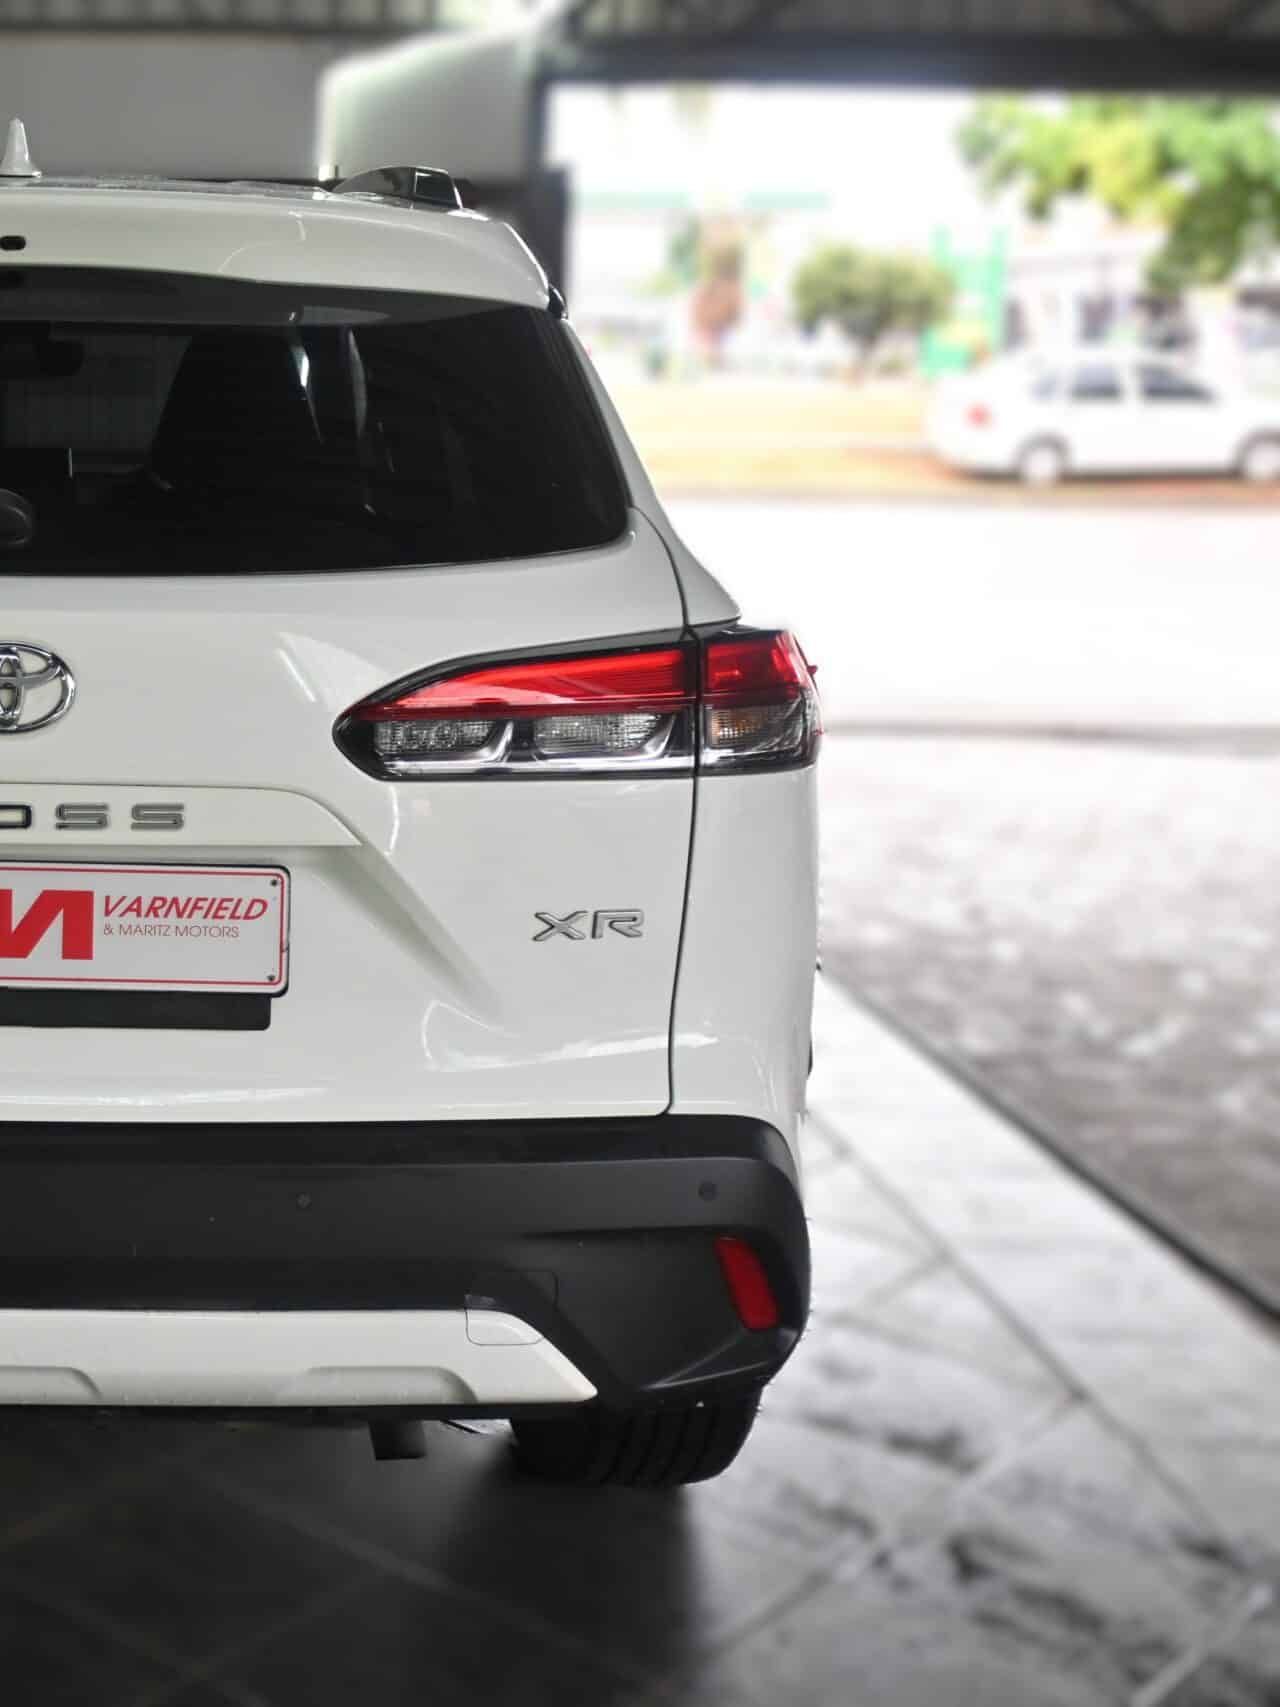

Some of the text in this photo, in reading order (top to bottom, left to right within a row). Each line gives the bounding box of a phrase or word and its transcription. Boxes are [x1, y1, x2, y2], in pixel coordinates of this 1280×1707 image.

[103, 896, 268, 920] VARNFIELD
[103, 922, 239, 938] & MARITZ MOTORS
[532, 909, 644, 942] XR
